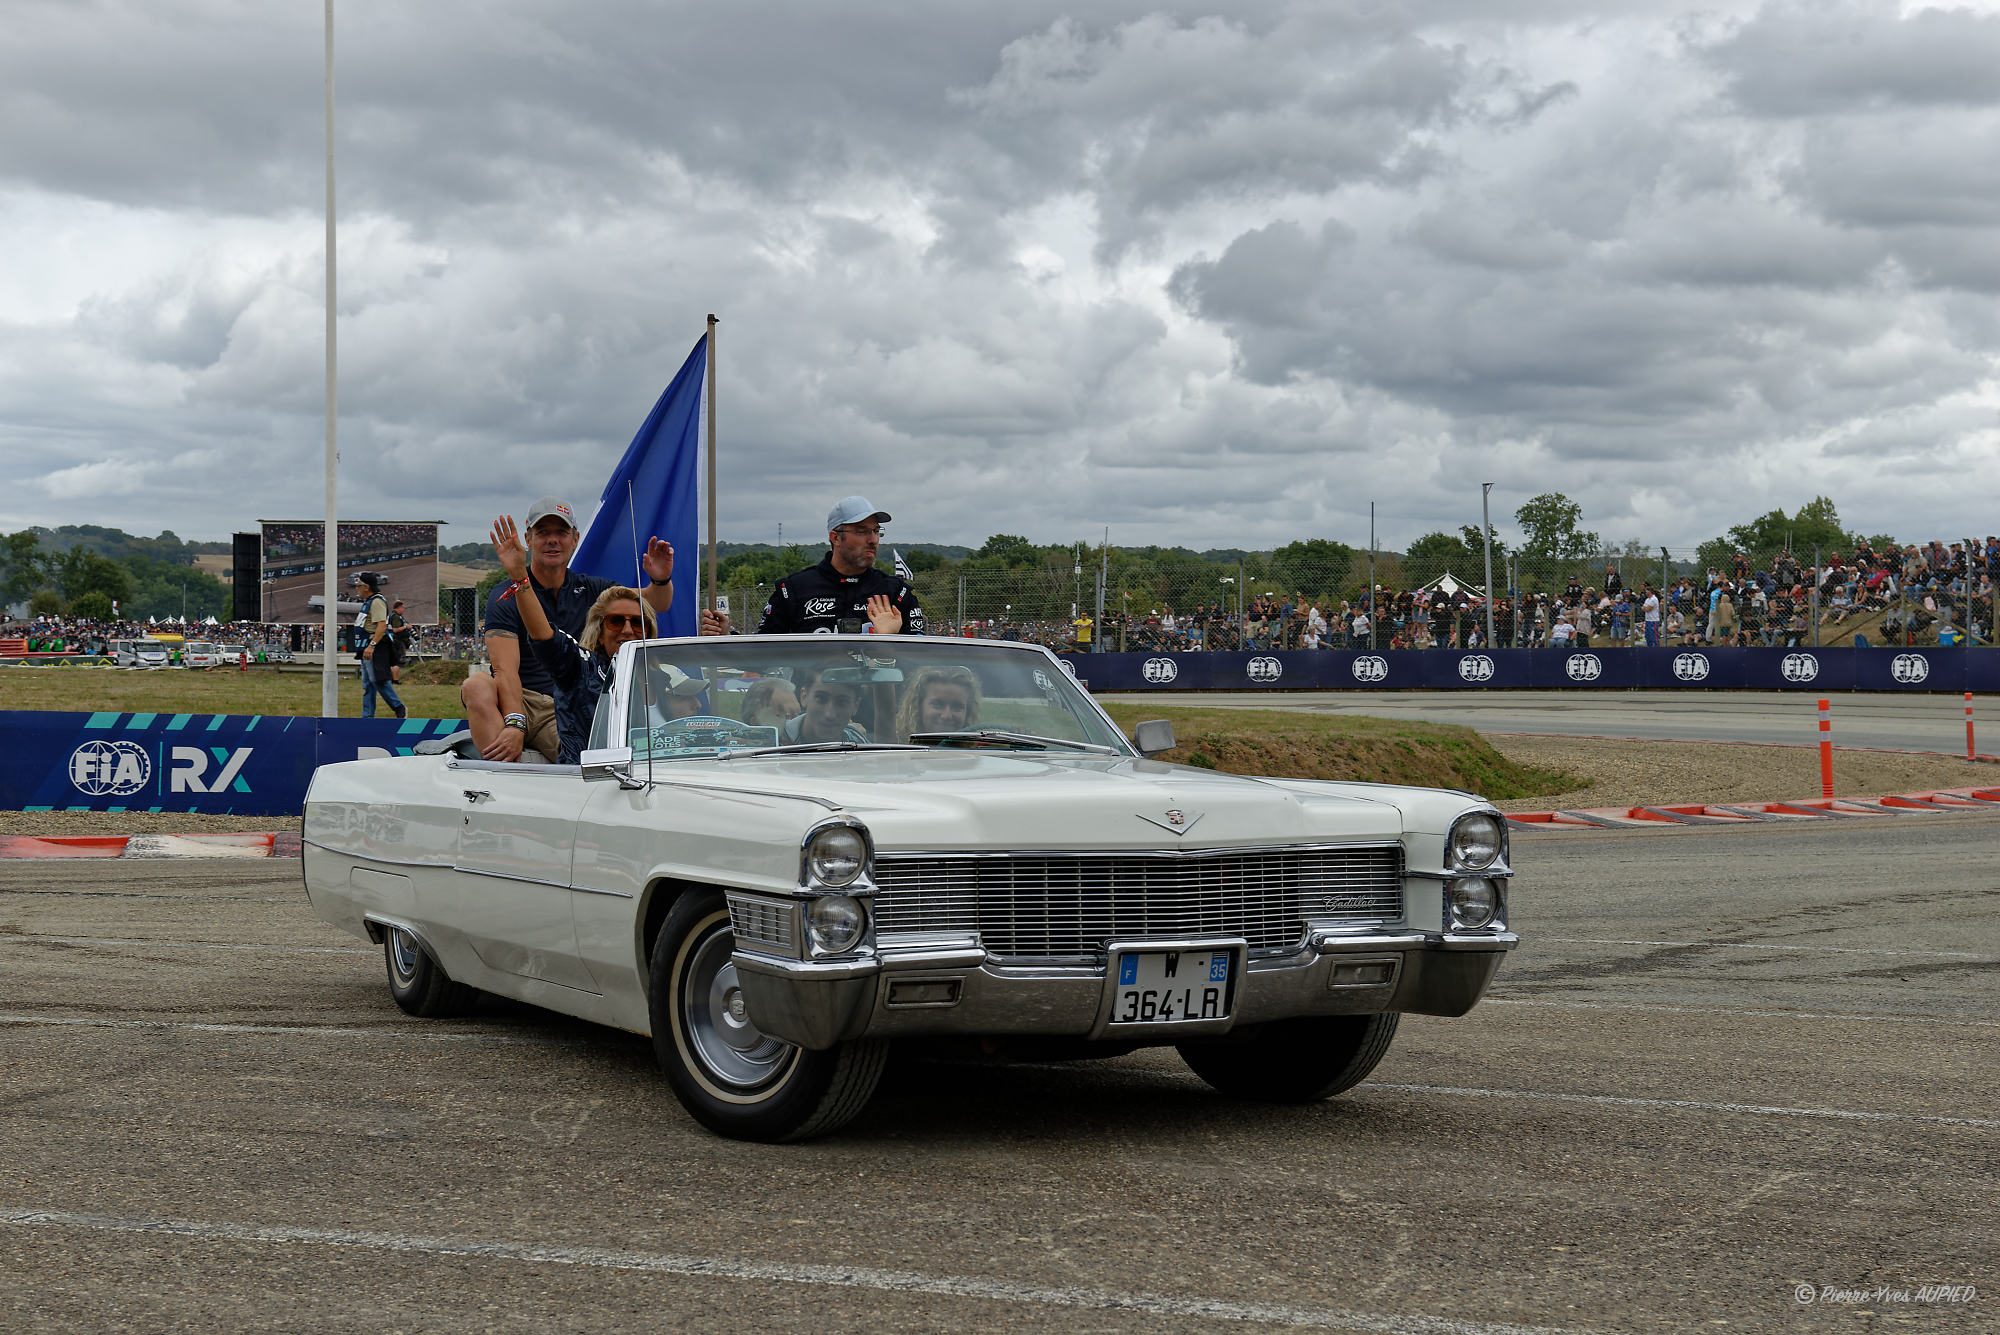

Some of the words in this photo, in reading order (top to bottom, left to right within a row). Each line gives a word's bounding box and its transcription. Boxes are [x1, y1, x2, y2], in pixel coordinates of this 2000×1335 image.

[804, 597, 836, 615] Rose
[171, 746, 254, 793] RX
[1323, 895, 1377, 911] Cadillac
[1165, 952, 1180, 978] W
[1211, 964, 1226, 978] 35
[1125, 970, 1132, 980] F
